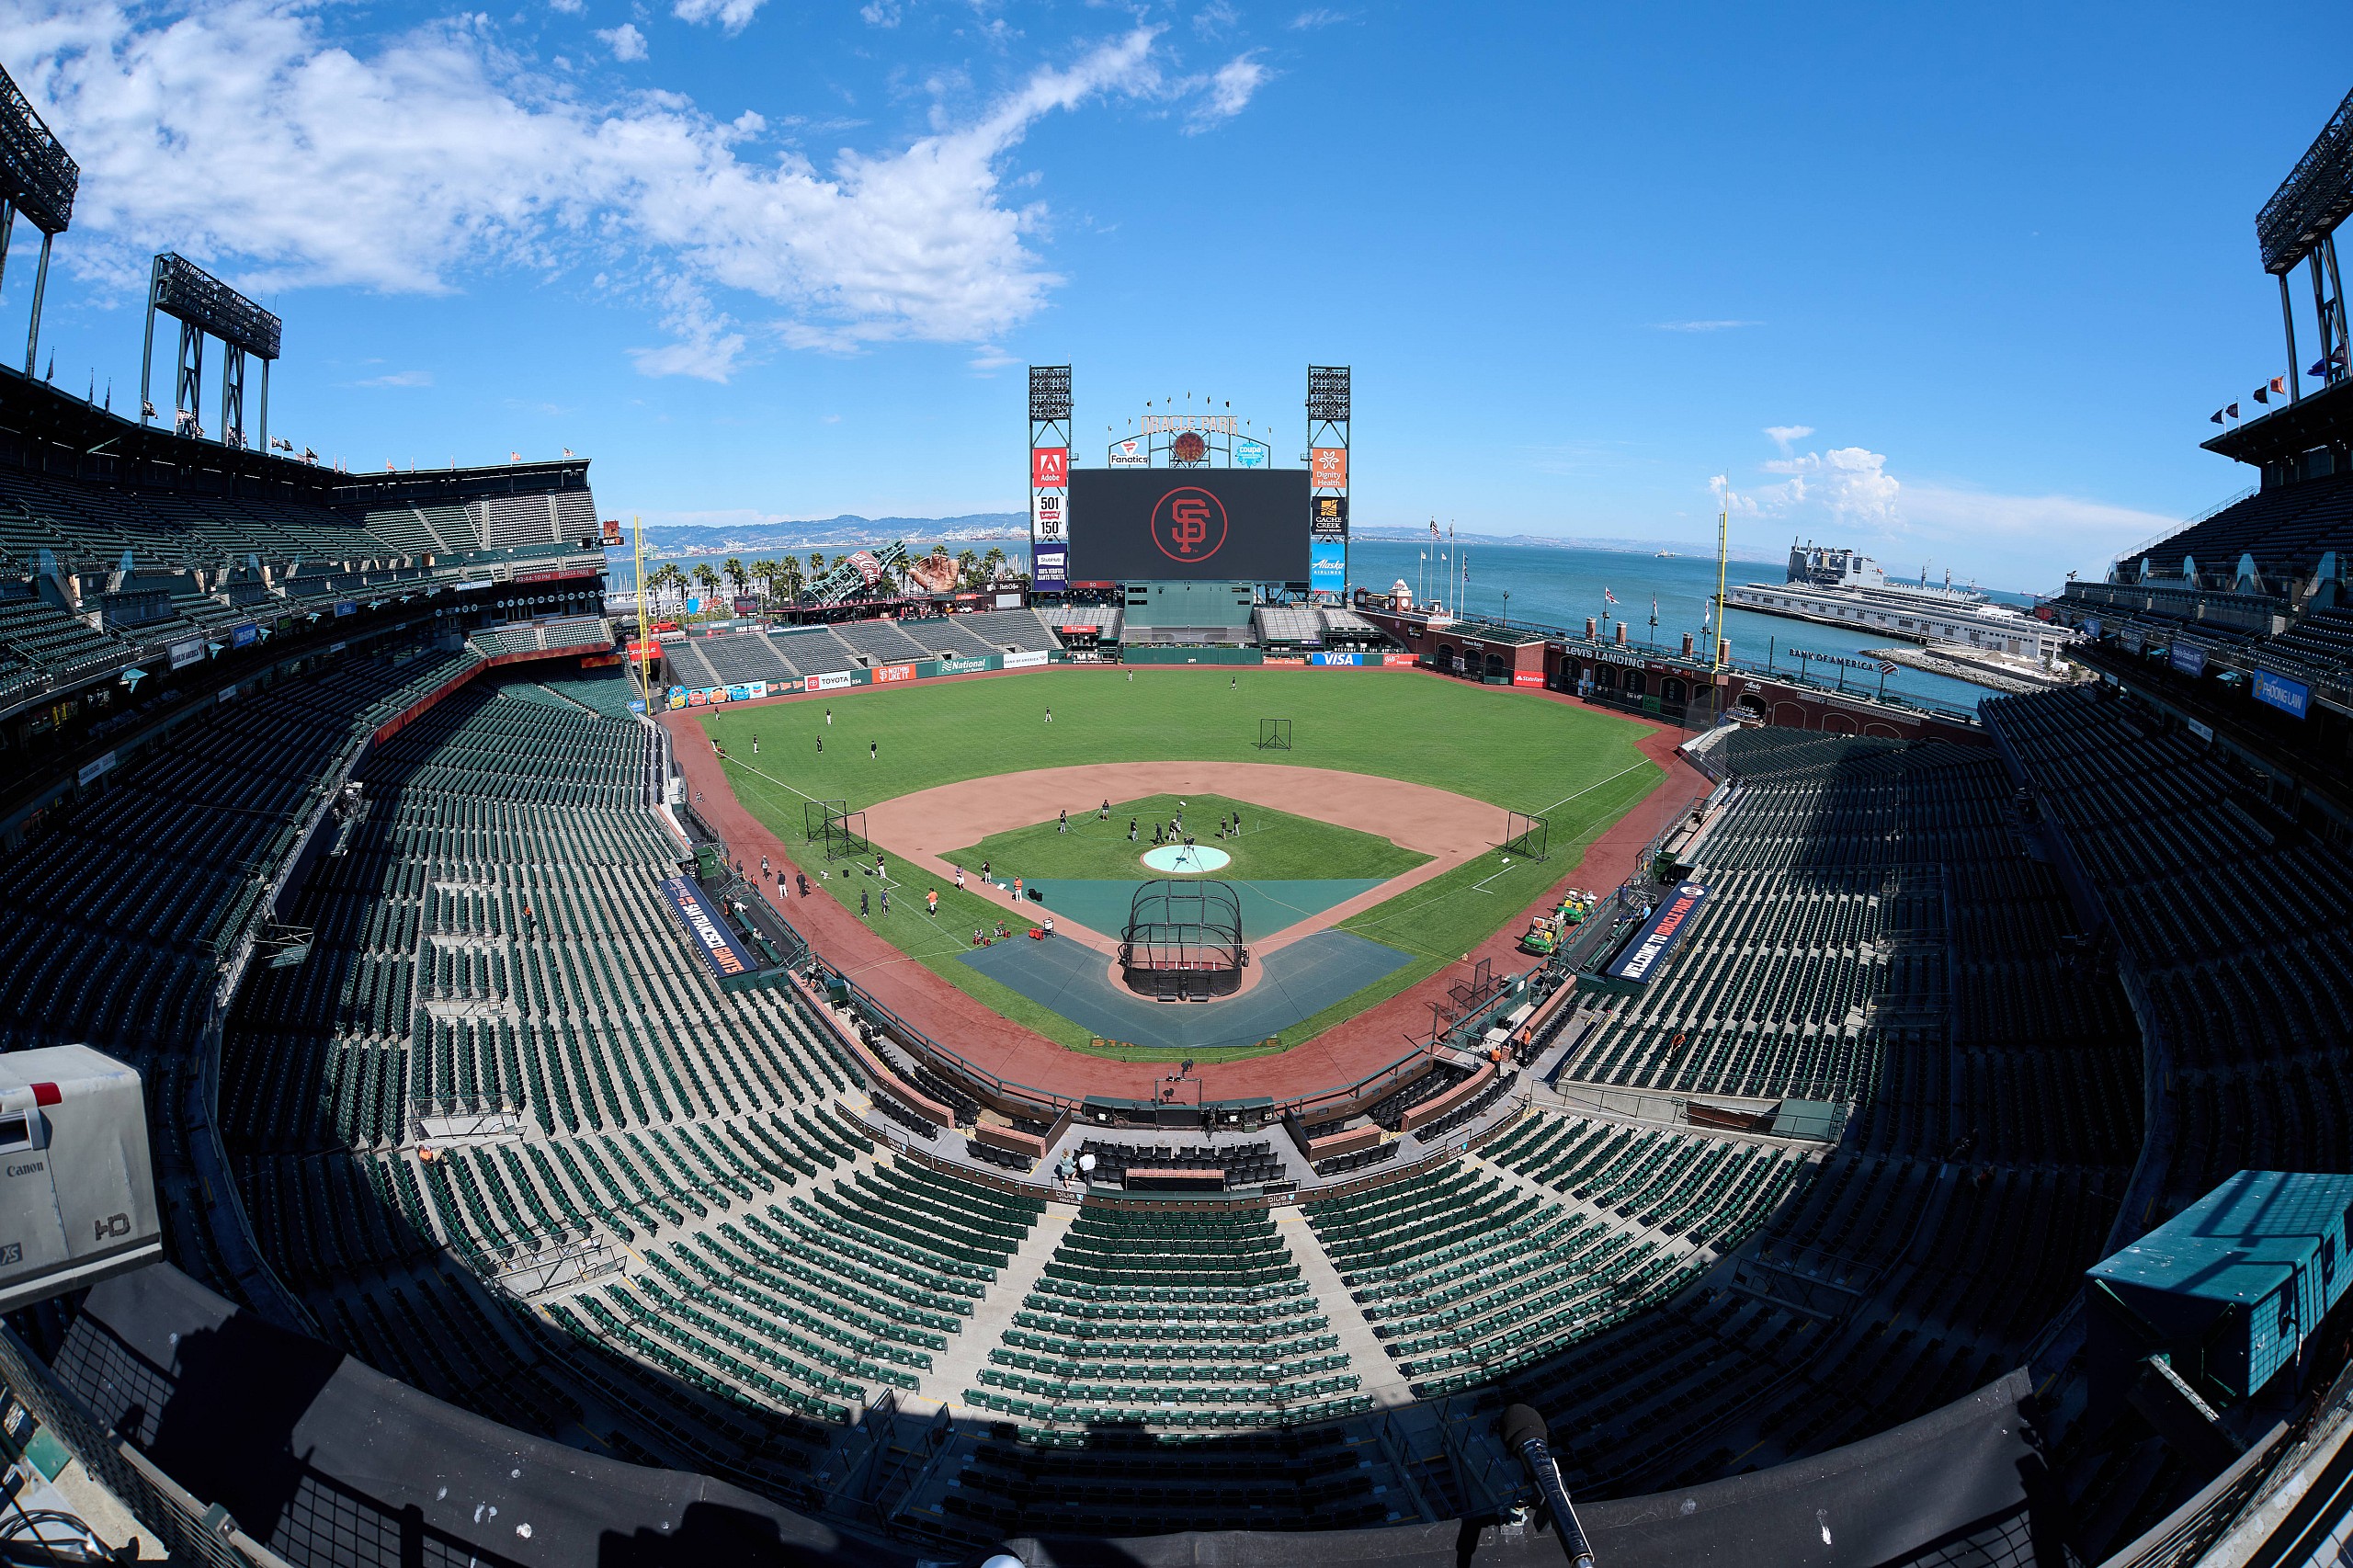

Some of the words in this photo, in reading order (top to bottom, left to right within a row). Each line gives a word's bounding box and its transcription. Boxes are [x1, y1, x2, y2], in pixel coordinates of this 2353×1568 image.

[1141, 415, 1196, 436] ORACLE
[1201, 415, 1239, 437] PARK
[1239, 446, 1262, 454] coupa
[1111, 454, 1148, 463] Fanatics
[1040, 473, 1060, 482] Adobe
[1316, 471, 1342, 480] Dignity
[1040, 497, 1059, 510] 501
[1172, 498, 1211, 553] SF
[1312, 559, 1345, 570] Alaska
[516, 574, 541, 583] 03:44:10
[558, 570, 575, 578] ORACLE
[648, 601, 683, 617] blue
[186, 649, 199, 660] AMERICA
[1323, 653, 1354, 665] VISA
[1595, 651, 1645, 669] LANDING
[1789, 648, 1814, 660] BANK
[1816, 653, 1828, 663] OF
[1829, 655, 1875, 672] AMERICA
[888, 665, 910, 675] NOTHING
[951, 658, 986, 670] National
[821, 676, 849, 685] TOYOTA
[888, 673, 902, 681] LIKE
[902, 671, 908, 679] IT
[2262, 682, 2288, 703] PHOONG
[2287, 689, 2303, 710] LAW
[682, 903, 705, 918] SAN
[1671, 897, 1696, 915] PARK
[1654, 913, 1685, 937] ORACLE
[689, 914, 727, 949] FRANCISCO
[1646, 933, 1668, 945] TO
[711, 947, 745, 974] GIANTS
[1620, 942, 1662, 979] WELCOME
[6, 1161, 44, 1177] Canon
[1056, 1190, 1074, 1199] blue
[94, 1212, 131, 1242] HD
